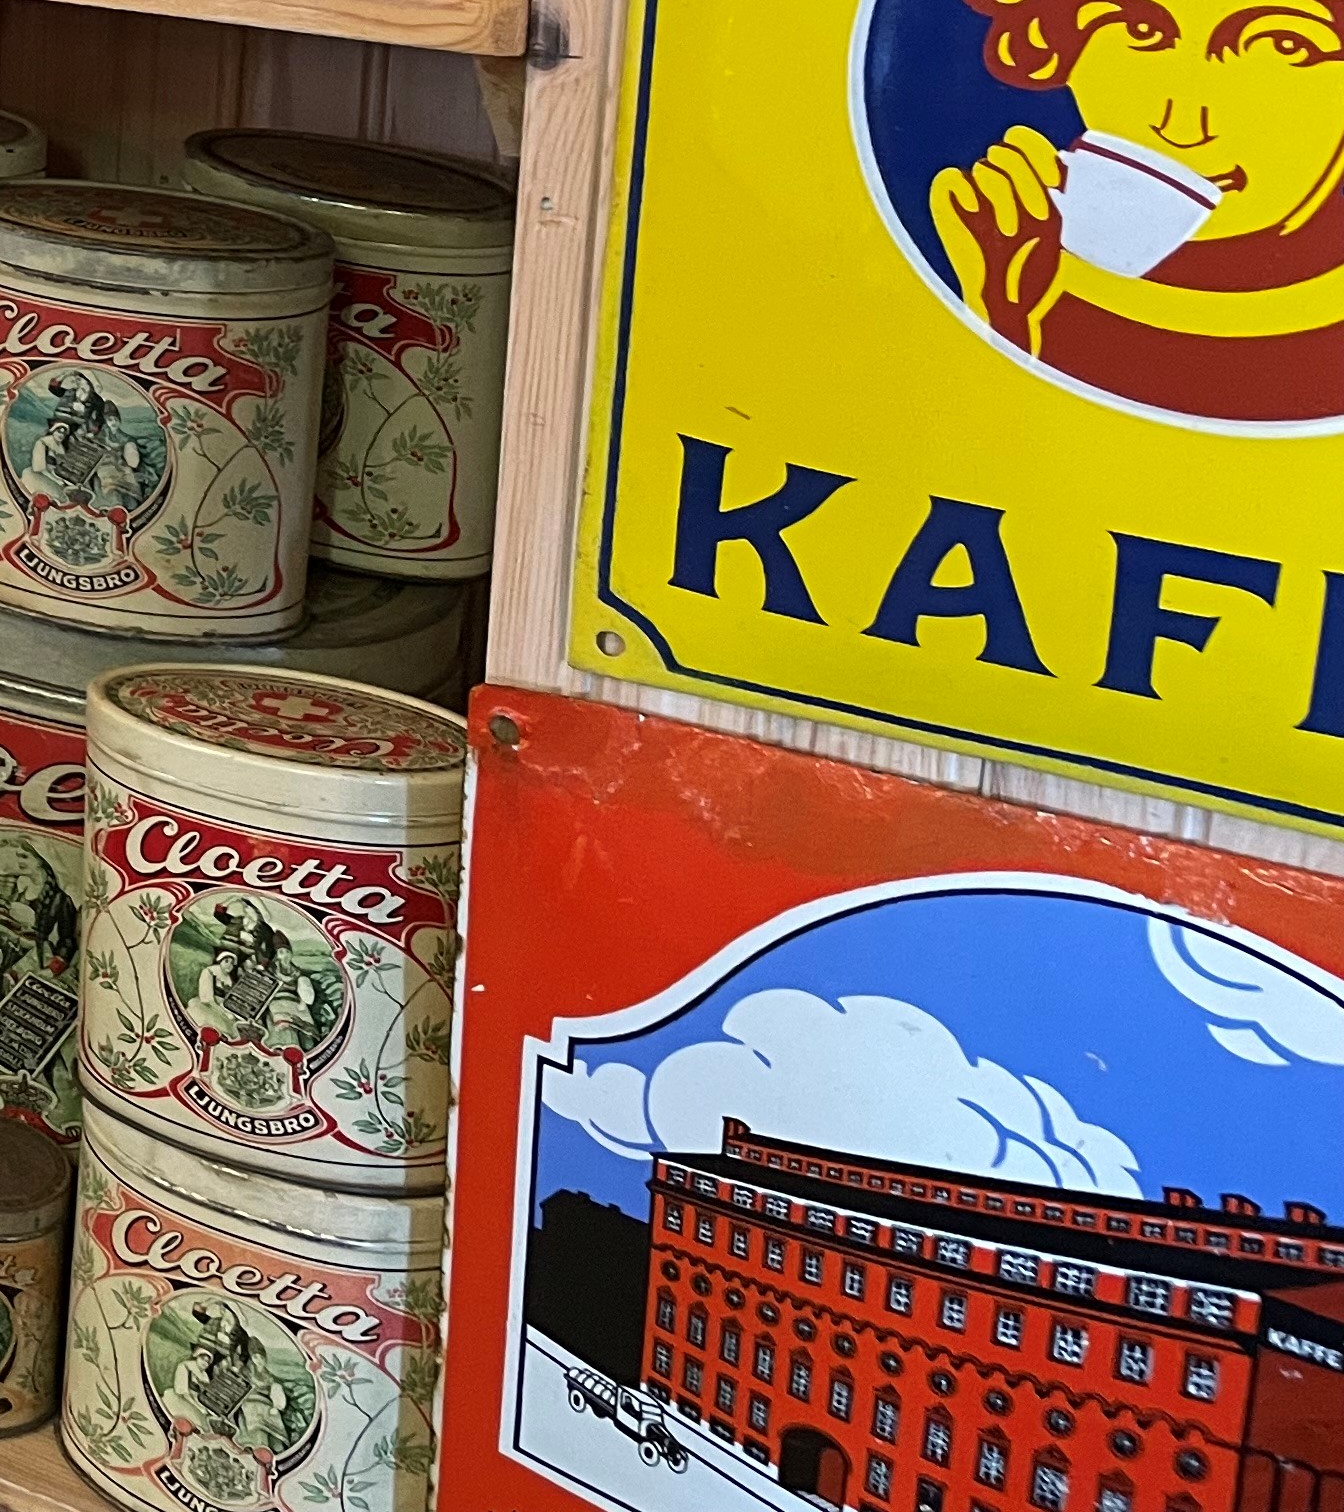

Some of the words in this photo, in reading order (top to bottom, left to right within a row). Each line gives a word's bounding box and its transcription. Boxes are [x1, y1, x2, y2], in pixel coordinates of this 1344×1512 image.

[19, 546, 137, 592] LJUNGSBRO
[161, 697, 397, 759] Cloetta
[124, 814, 407, 924] Cloetta
[187, 1083, 317, 1136] LJUNGSBRO
[111, 1209, 381, 1343] Cloetta
